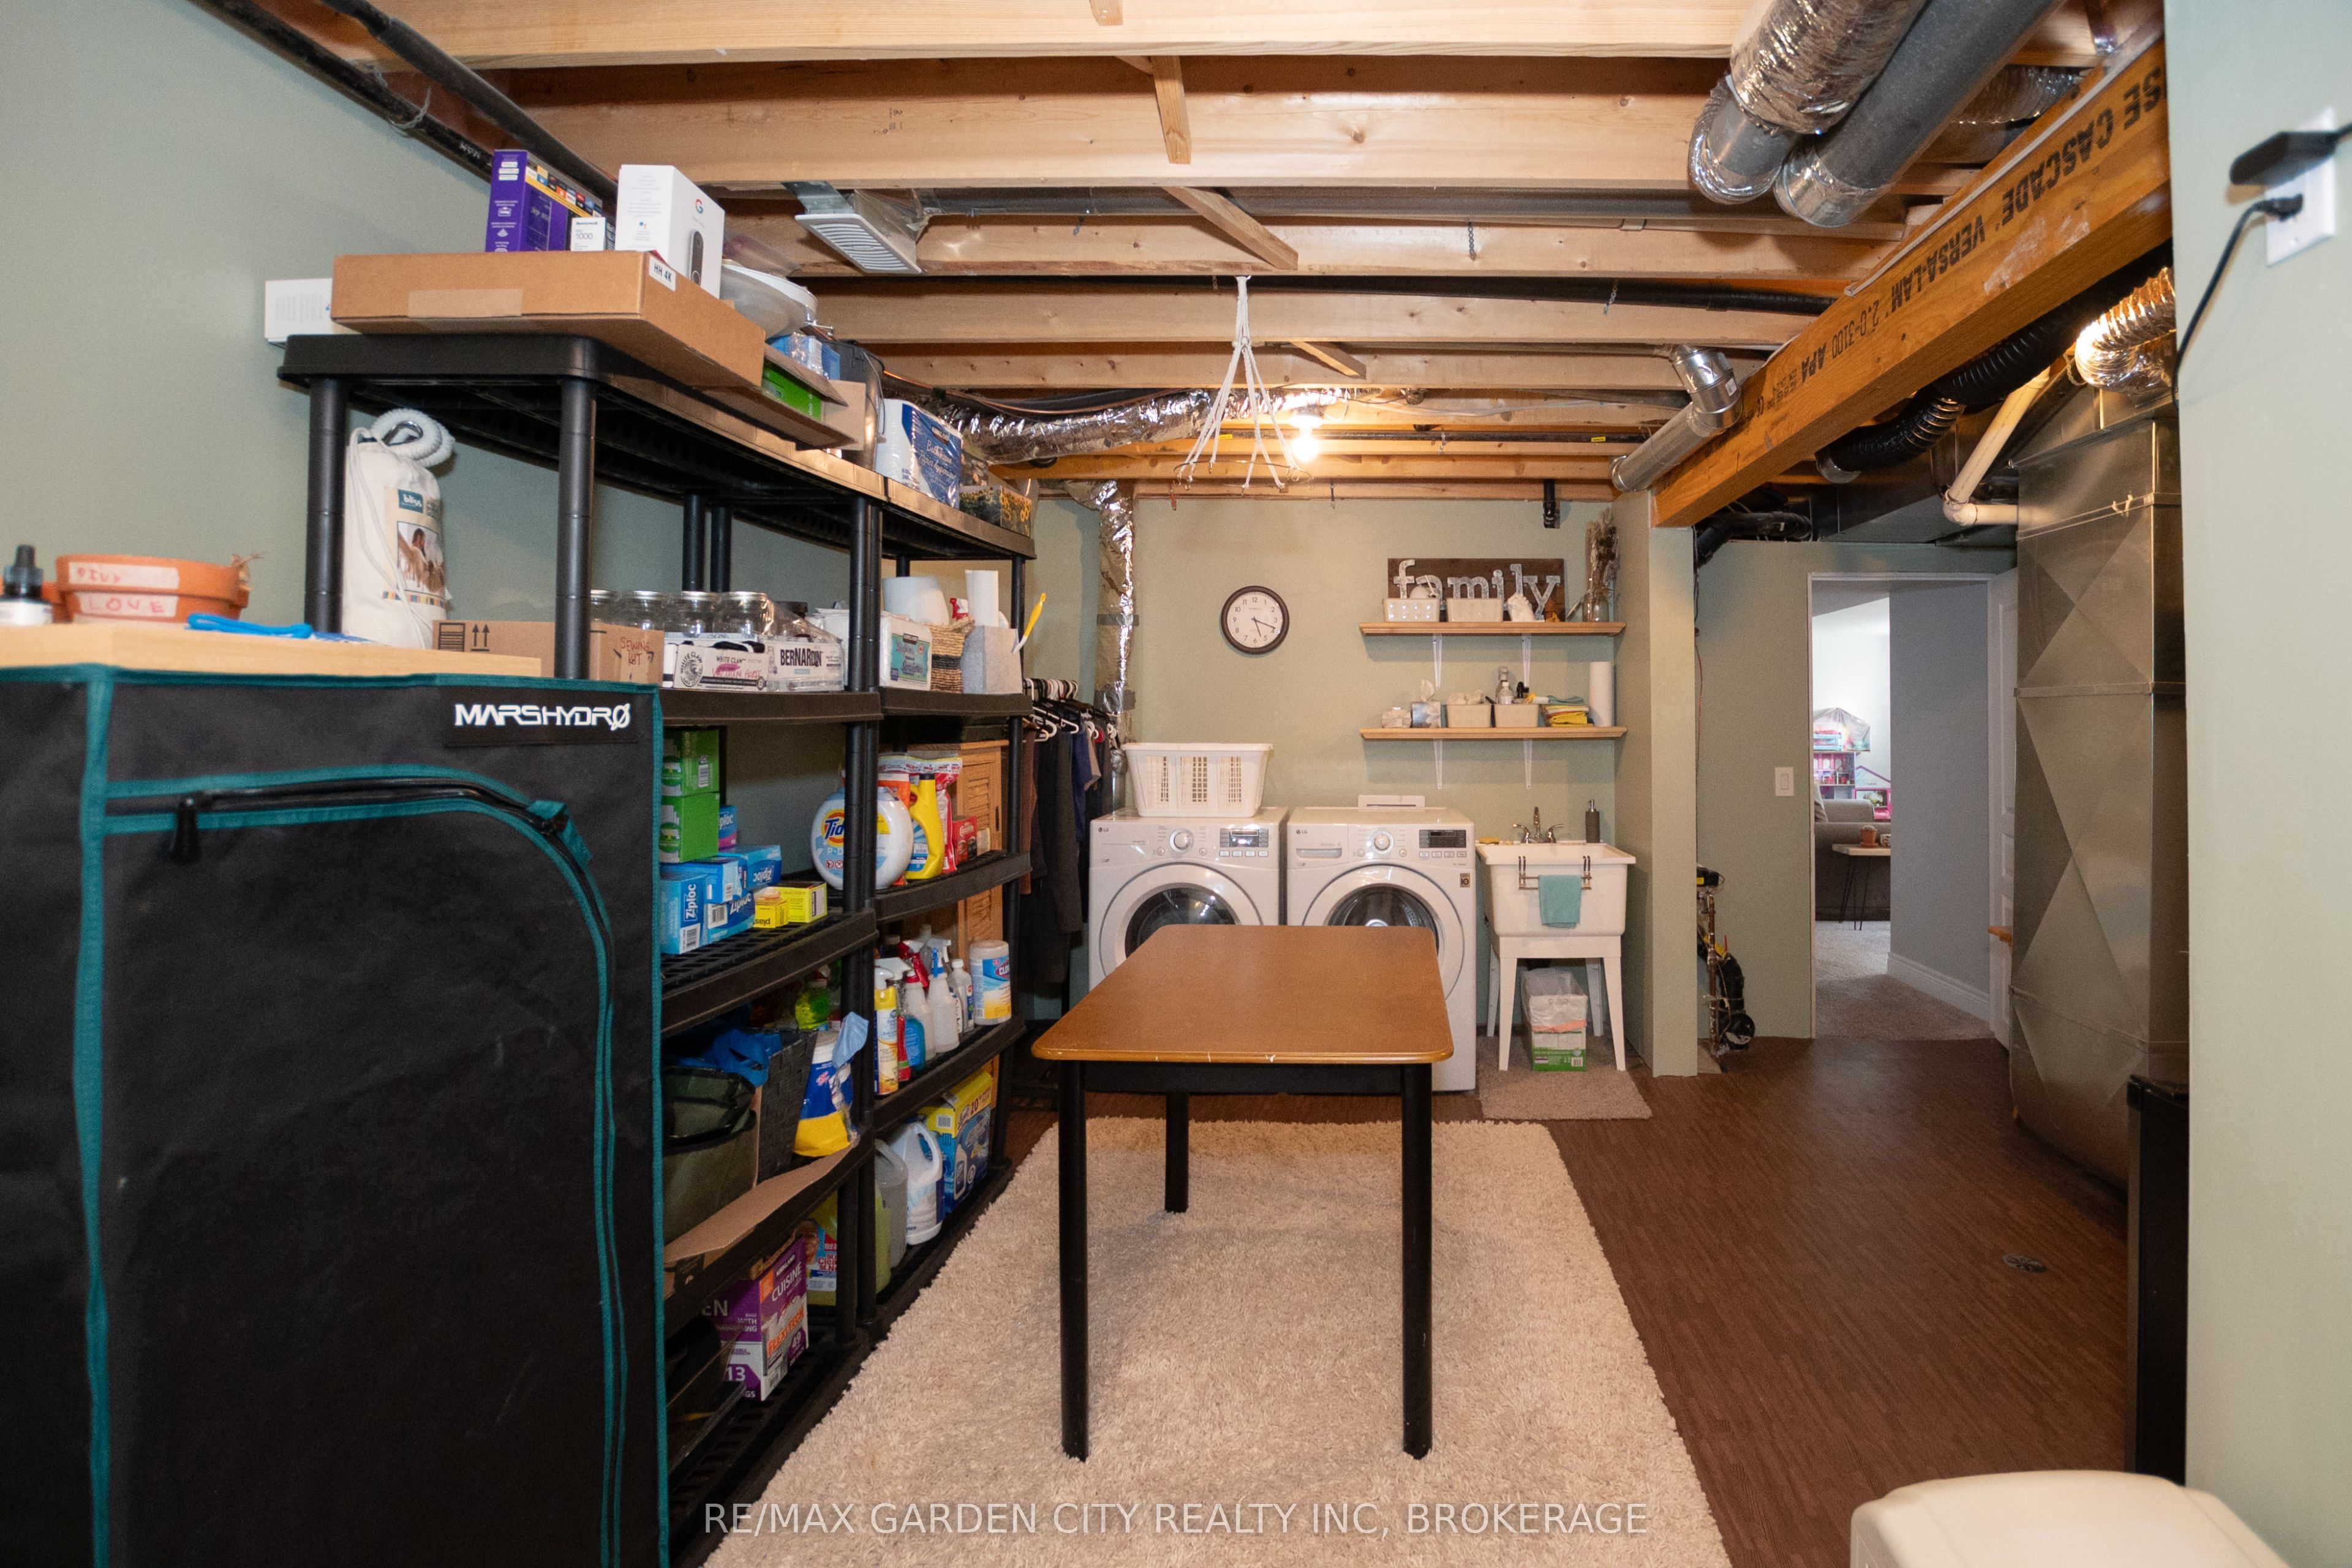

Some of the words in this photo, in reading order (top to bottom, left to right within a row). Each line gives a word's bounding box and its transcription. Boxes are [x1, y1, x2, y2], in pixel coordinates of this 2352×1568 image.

[2000, 106, 2114, 226] CASCADE
[576, 232, 593, 241] 1000
[654, 262, 663, 277] HH
[664, 270, 672, 283] 4K
[1890, 216, 1986, 315] VERSA-LAM
[1801, 342, 1827, 384] APA
[1393, 559, 1561, 620] family
[89, 598, 165, 613] LOVE
[621, 636, 649, 652] SEWING
[780, 647, 822, 668] BERNARDIN
[719, 813, 734, 828] ploc
[824, 818, 845, 840] Tid
[685, 883, 696, 919] Ziploc
[772, 1261, 802, 1302] CUISINE
